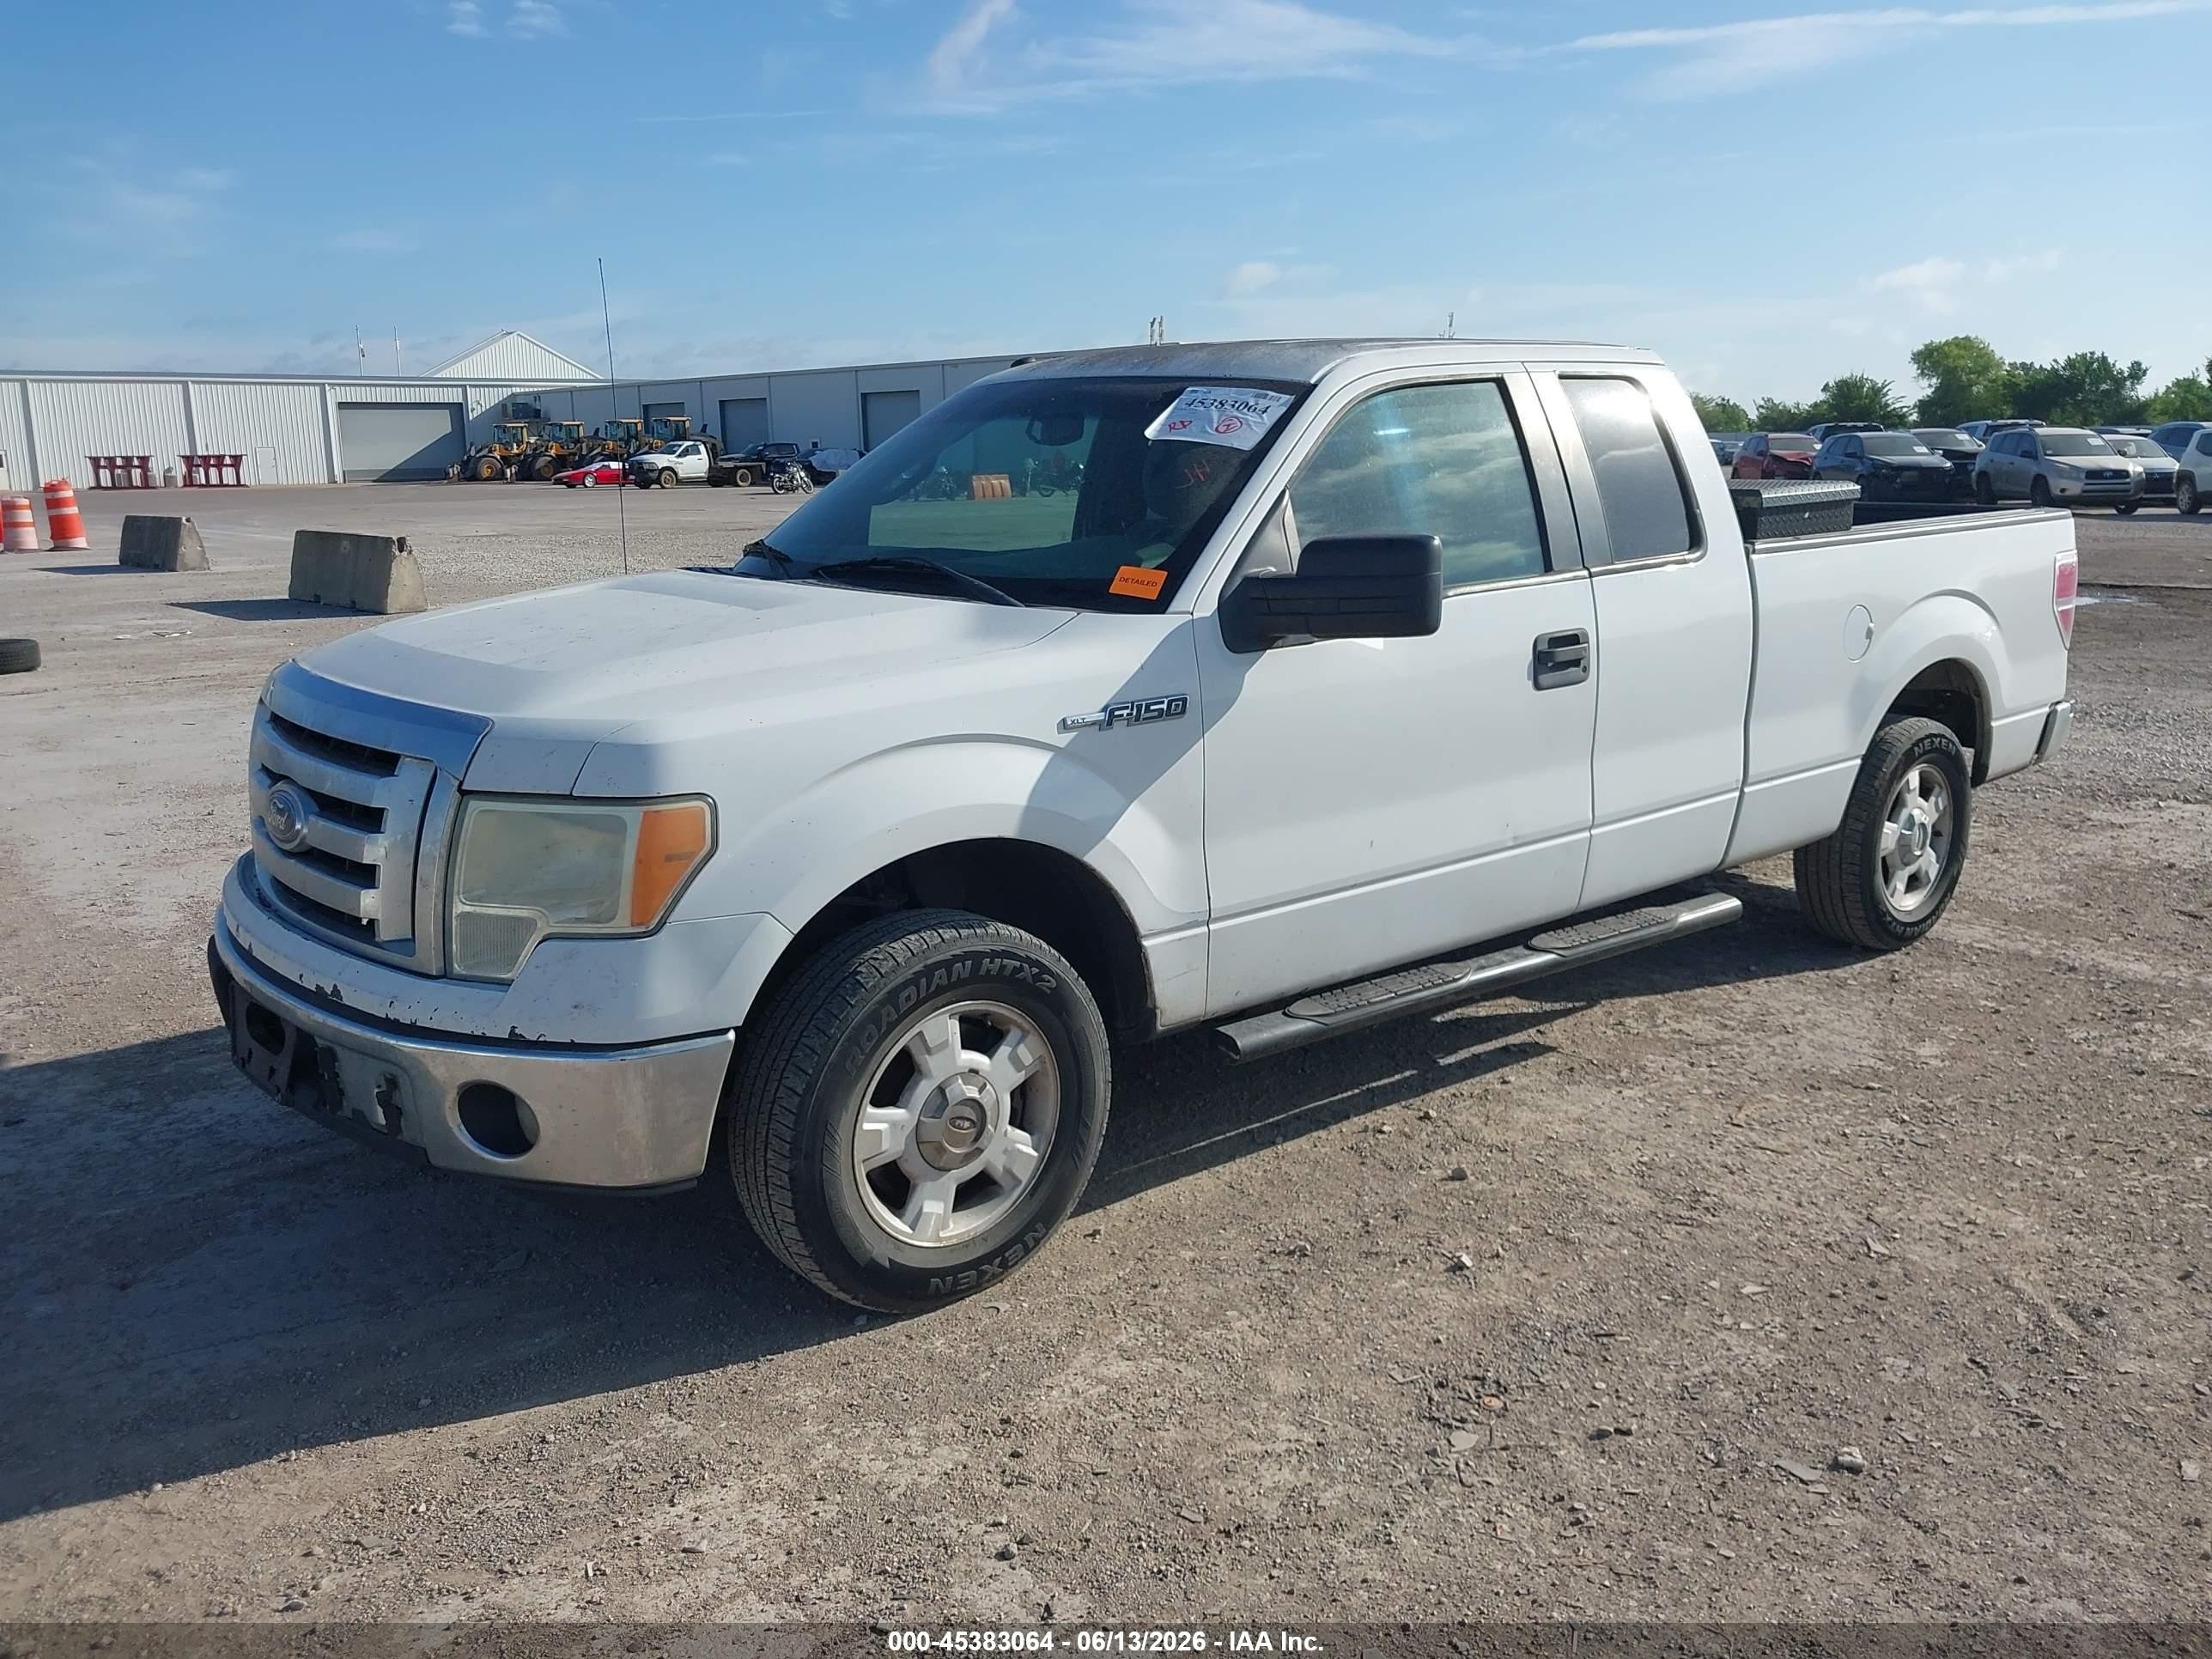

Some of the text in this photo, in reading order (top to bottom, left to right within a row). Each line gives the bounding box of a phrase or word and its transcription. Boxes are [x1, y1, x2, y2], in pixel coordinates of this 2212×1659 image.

[1185, 398, 1272, 415] 45383064
[1119, 576, 1158, 587] DETAILED
[1069, 696, 1189, 726] XLT F-150
[1914, 738, 1956, 757] NEXEN
[268, 799, 289, 830] Ford
[844, 957, 1058, 1074] ROADIAN HTX2
[927, 1222, 1048, 1297] NEXEN
